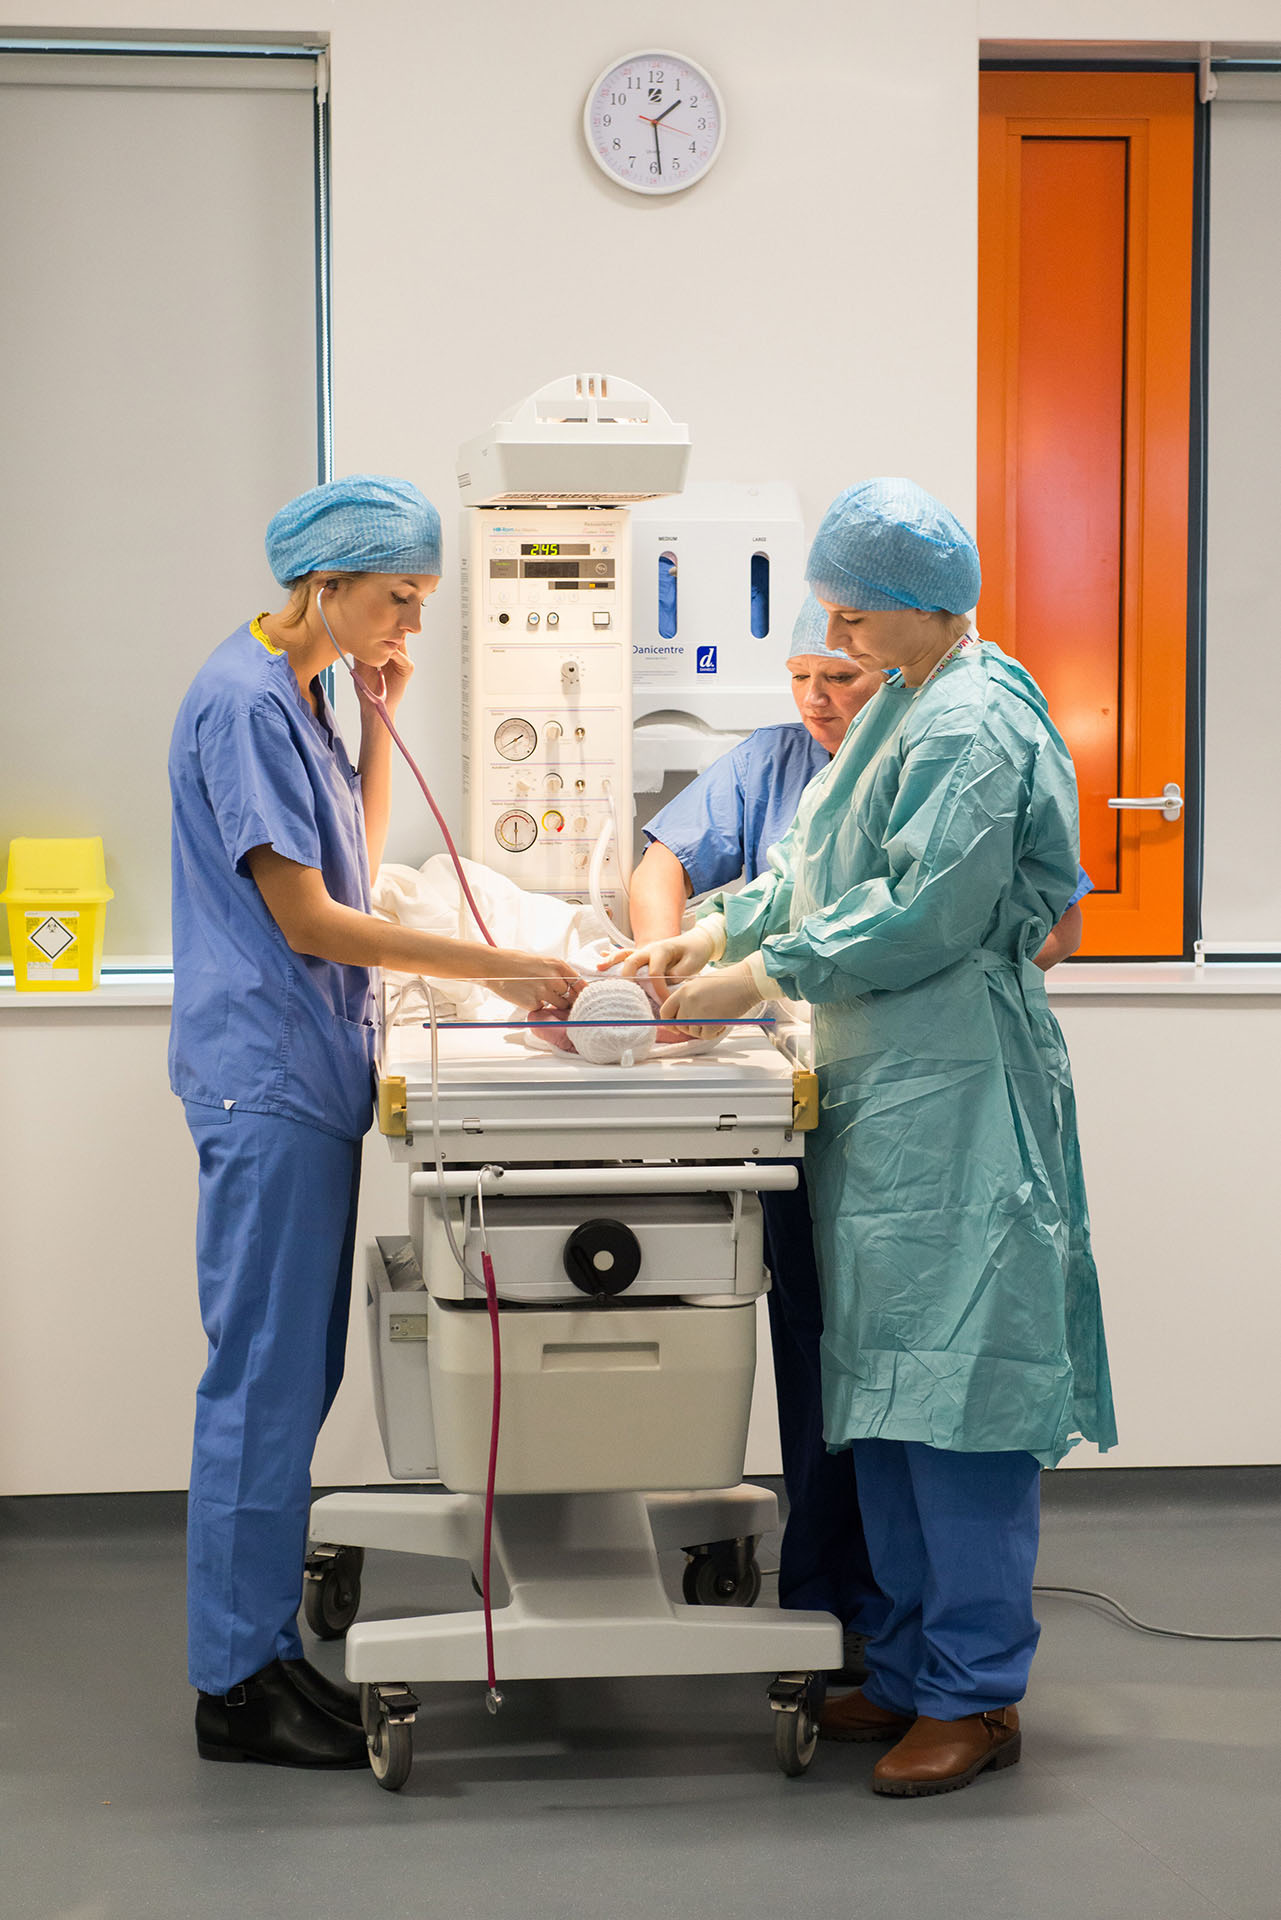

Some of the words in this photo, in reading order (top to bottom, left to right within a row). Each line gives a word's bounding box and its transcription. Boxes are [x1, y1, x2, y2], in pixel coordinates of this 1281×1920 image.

[648, 70, 664, 83] 12
[627, 77, 641, 89] 11
[674, 78, 681, 91] 1
[611, 93, 627, 105] 10
[689, 96, 698, 108] 2
[603, 114, 612, 127] 9
[697, 118, 706, 130] 3
[612, 138, 621, 150] 8
[688, 140, 696, 153] 4
[628, 156, 637, 168] 7
[649, 161, 658, 174] 6
[672, 158, 680, 169] 5
[633, 645, 684, 654] Danicentre
